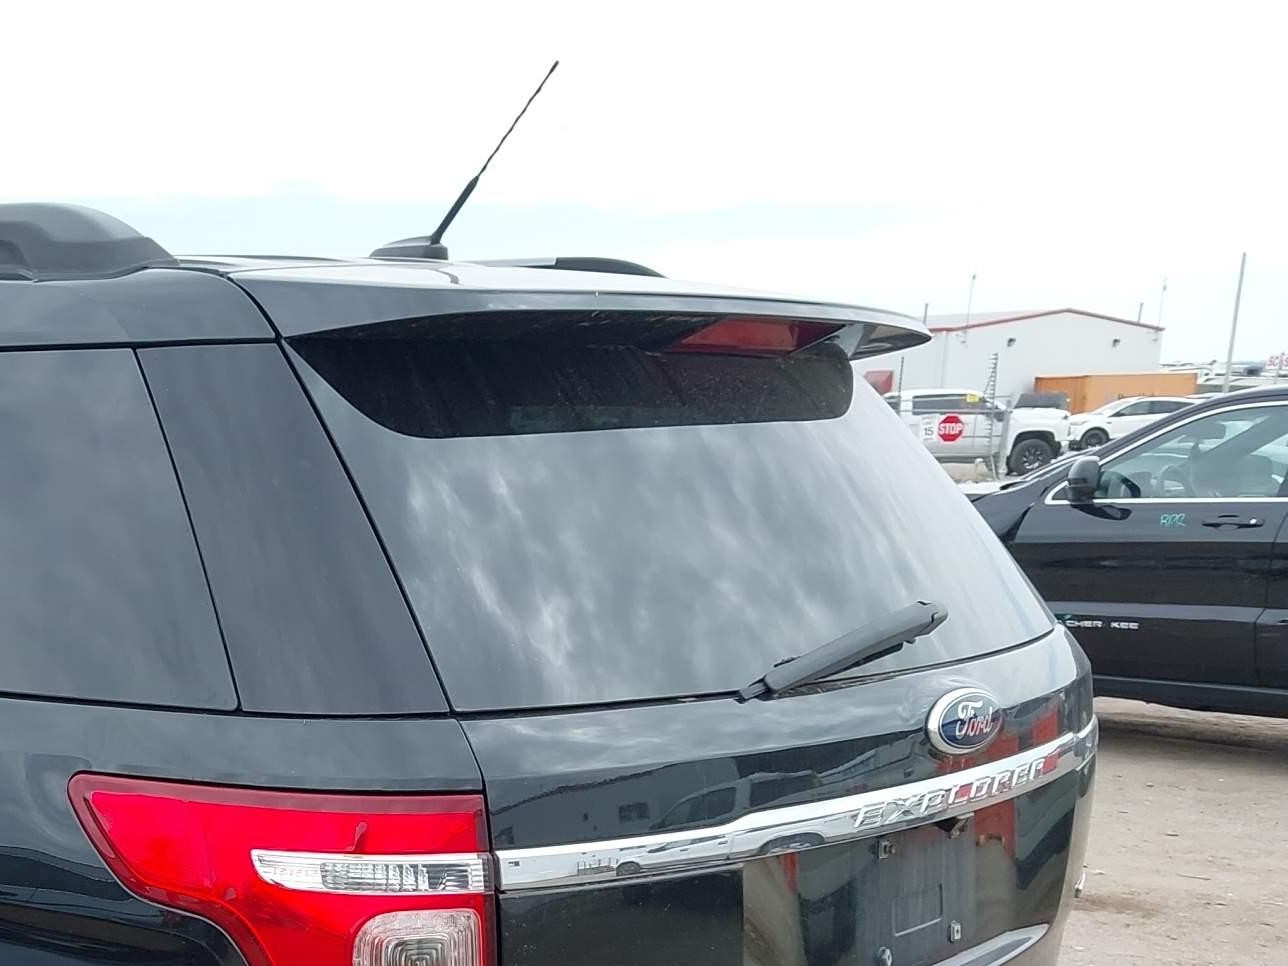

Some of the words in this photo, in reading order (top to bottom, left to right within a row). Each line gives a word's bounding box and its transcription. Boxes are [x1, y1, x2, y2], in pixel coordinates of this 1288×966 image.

[924, 426, 934, 436] 15
[939, 422, 963, 434] STOP
[955, 700, 994, 737] Ford
[854, 757, 1050, 828] EXPLORER
